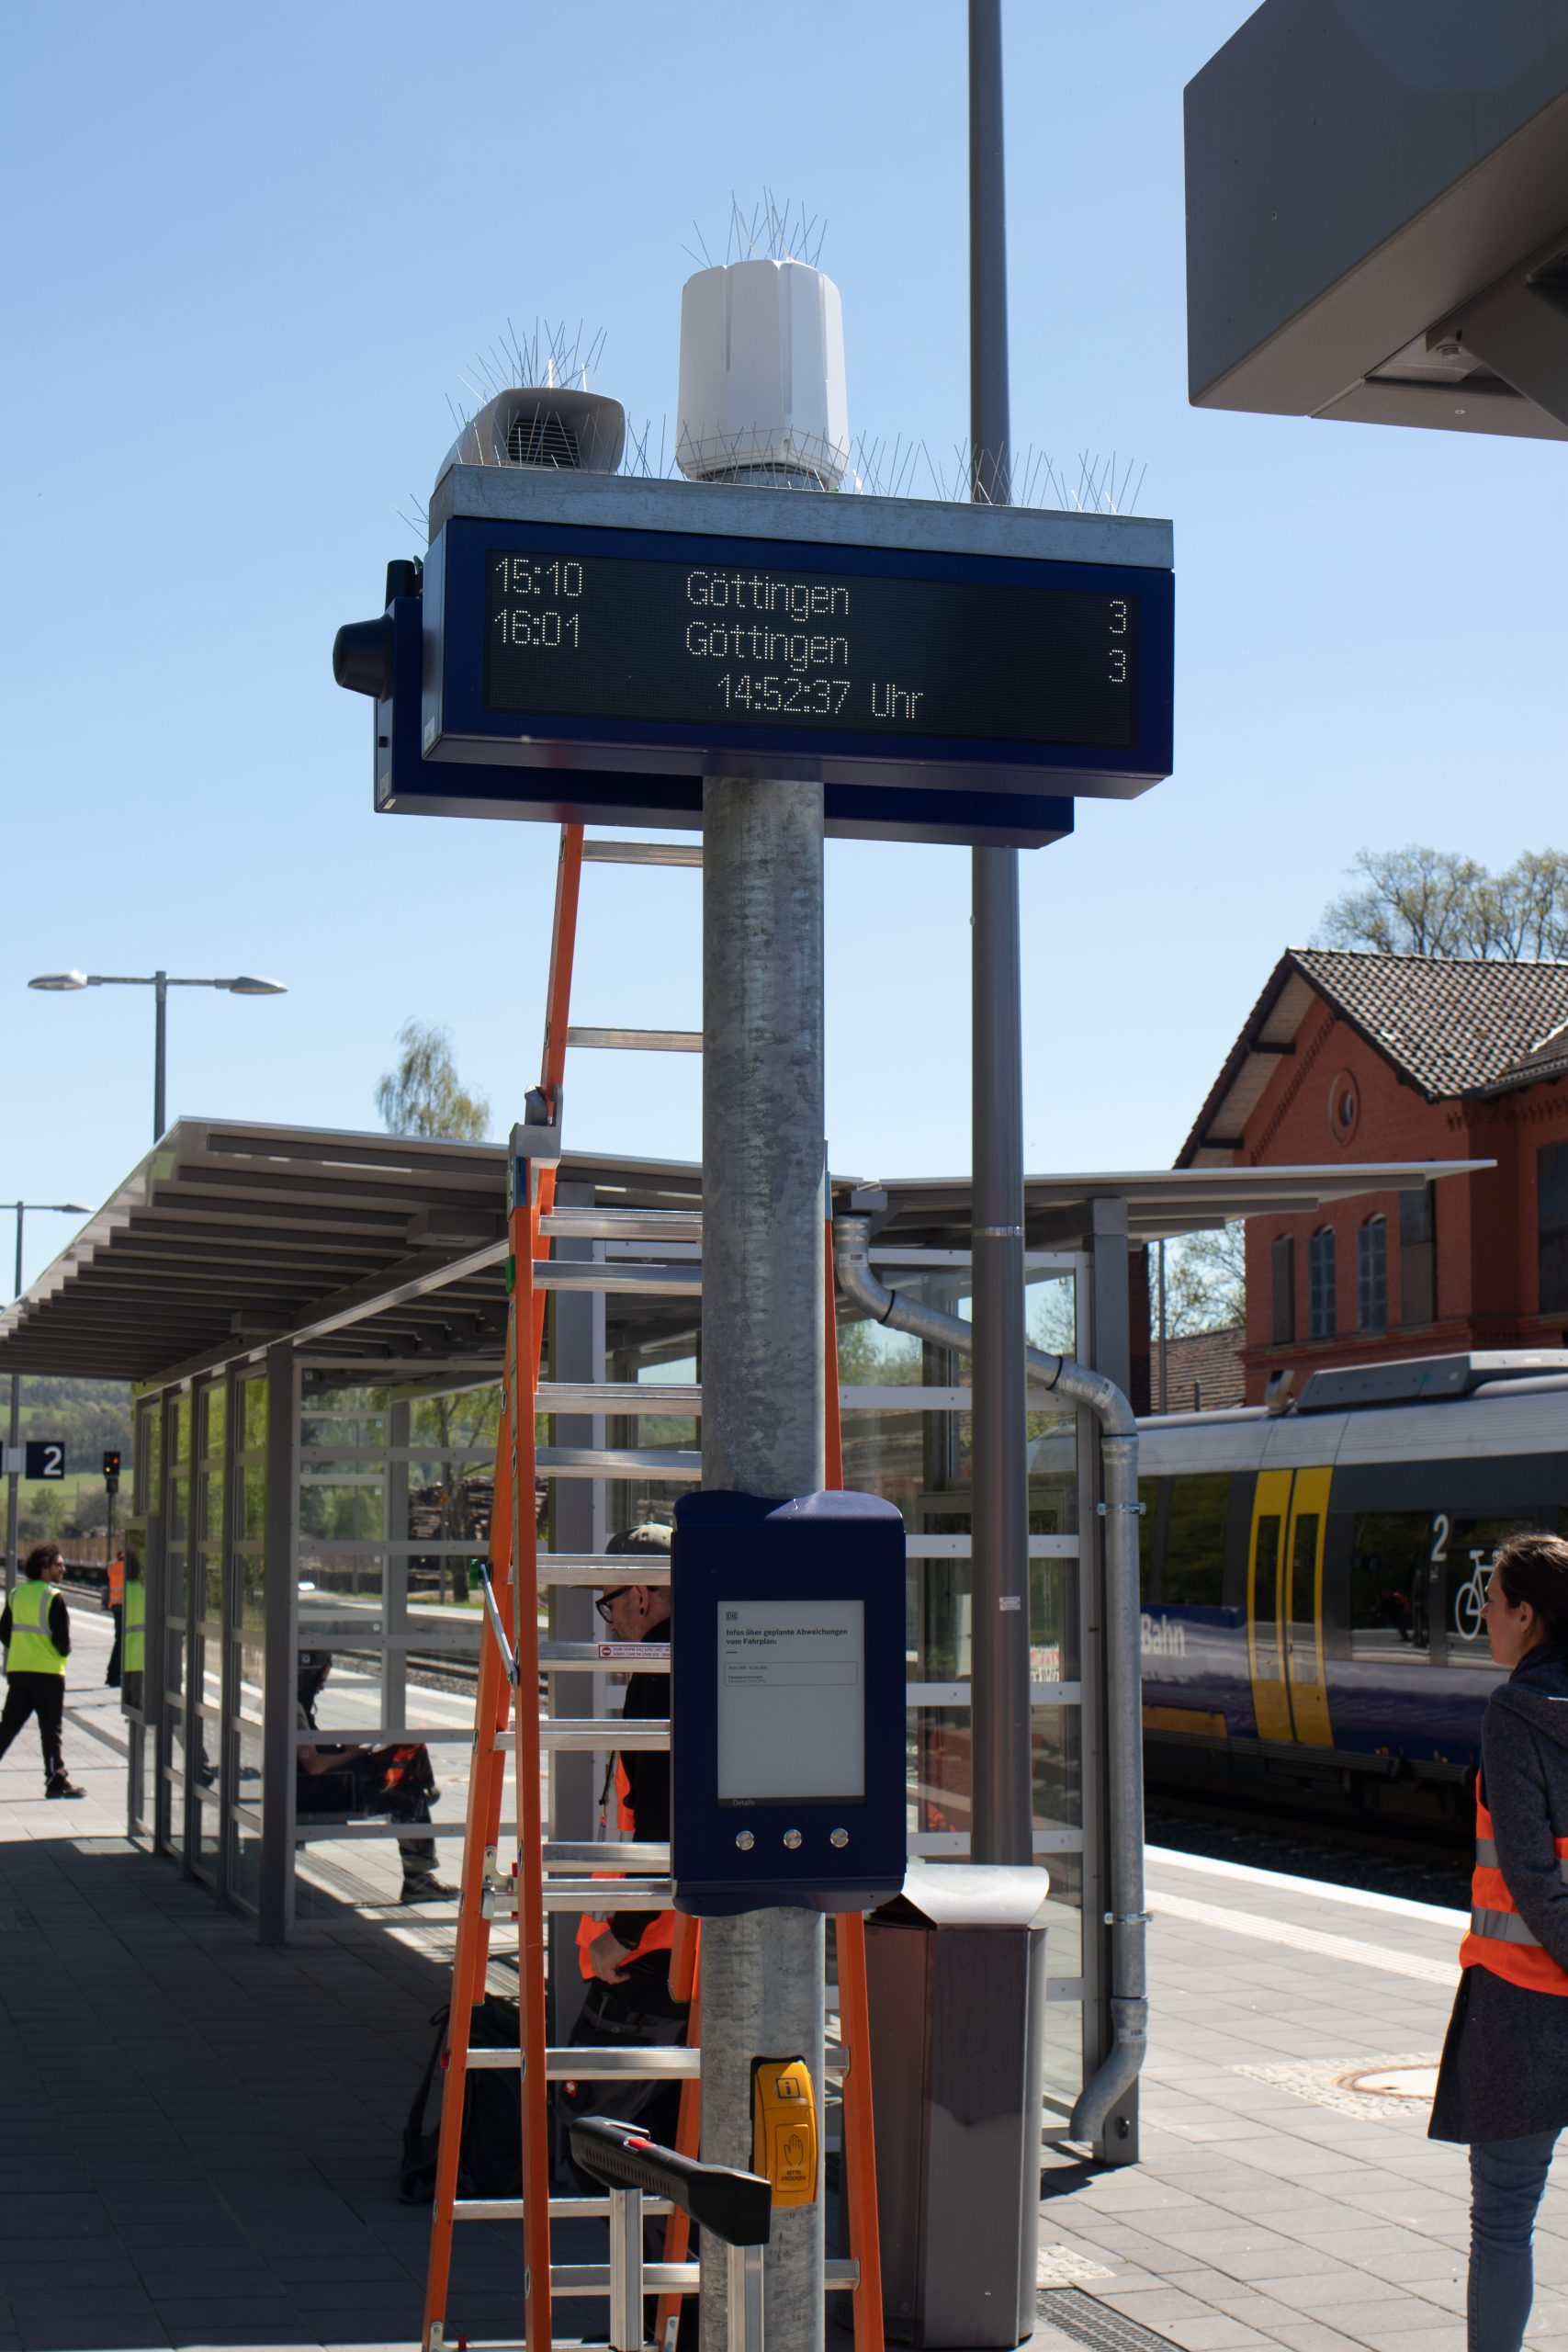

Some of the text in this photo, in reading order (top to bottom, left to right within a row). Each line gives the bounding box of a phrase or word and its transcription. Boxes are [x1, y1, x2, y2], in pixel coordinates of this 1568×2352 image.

[495, 558, 1127, 634] 15:10 Göttingen 3
[494, 609, 1126, 683] 16:01 Göttingen 3
[717, 673, 924, 719] 14:52:37 Uhr
[43, 1445, 62, 1476] 2
[1431, 1513, 1449, 1562] 2
[746, 1628, 763, 1636] über
[763, 1629, 795, 1637] geplante
[796, 1628, 848, 1637] Abweichungen
